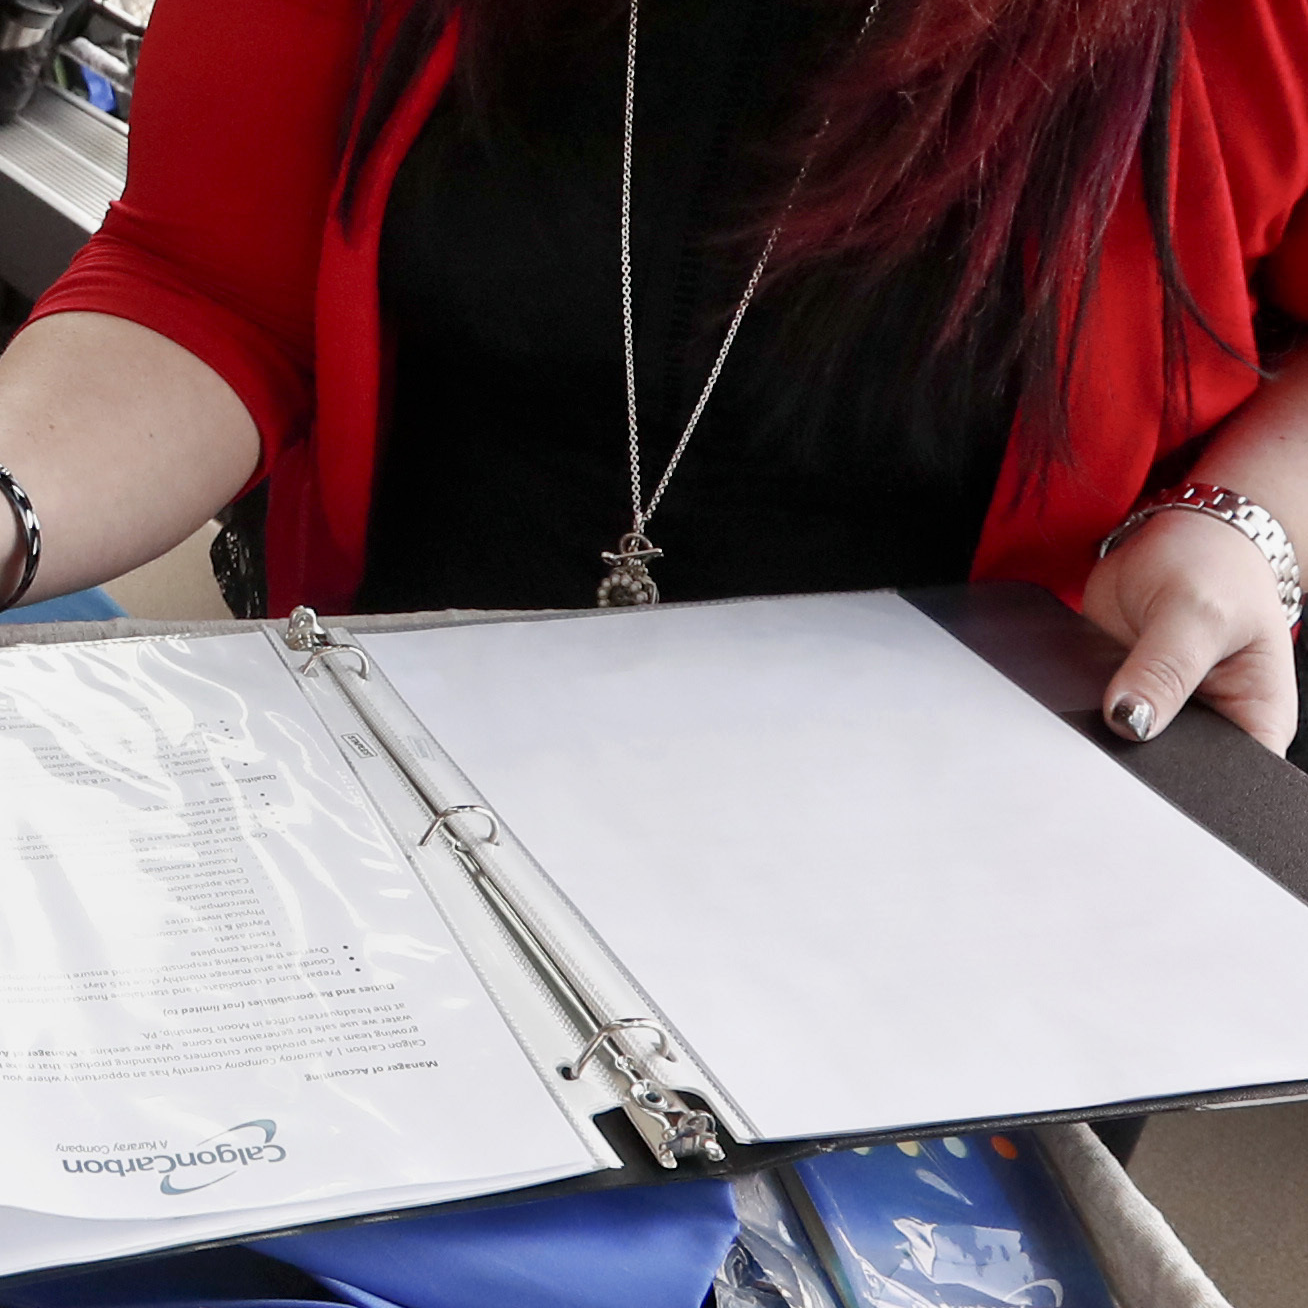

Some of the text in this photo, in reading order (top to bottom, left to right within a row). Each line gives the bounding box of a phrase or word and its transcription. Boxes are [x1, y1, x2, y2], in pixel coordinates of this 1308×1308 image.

[210, 775, 277, 788] Qualificaons
[213, 832, 268, 845] Coodinate
[198, 857, 239, 869] Account
[194, 867, 244, 879] Derivative
[167, 877, 250, 893] Cash application
[175, 888, 255, 903] Product costing
[189, 898, 260, 912] Intercompany
[224, 908, 266, 920] Physical
[234, 919, 271, 931] Payroll
[214, 930, 277, 942] Fixed assets
[190, 941, 282, 957] Percent complete
[286, 947, 329, 958] Overee
[254, 965, 273, 974] and
[277, 957, 336, 971] Coordiate
[163, 973, 207, 984] monthly
[210, 968, 252, 979] manage
[278, 969, 342, 982] Prepartion
[265, 977, 276, 985] of
[359, 983, 395, 993] Duties
[223, 1000, 245, 1010] (not
[248, 991, 333, 1008] Reponsibilities
[181, 1005, 220, 1016] limited
[372, 1004, 391, 1014] the
[392, 1002, 406, 1011] at
[266, 1018, 296, 1028] office
[339, 1020, 359, 1029] use
[362, 1019, 378, 1027] we
[382, 1014, 413, 1025] water
[217, 1022, 251, 1032] Moon
[295, 1026, 313, 1036] for
[375, 1025, 419, 1039] growing
[215, 1038, 227, 1046] to
[329, 1035, 341, 1043] as
[344, 1032, 372, 1042] team
[156, 1043, 174, 1051] We
[244, 1045, 262, 1054] our
[266, 1039, 307, 1053] provide
[346, 1043, 386, 1054] Carbon
[388, 1039, 426, 1050] Calgon
[92, 1046, 132, 1056] seekin
[183, 1049, 241, 1061] customers
[5, 1062, 34, 1071] mke
[37, 1062, 60, 1071] that
[65, 1058, 112, 1070] product
[115, 1055, 181, 1067] outstanding
[225, 1058, 276, 1070] Company
[149, 1069, 170, 1078] has
[171, 1063, 222, 1076] currently
[304, 1059, 439, 1082] Manager of Accounting
[2, 1073, 23, 1083] you
[26, 1074, 61, 1083] where
[64, 1071, 130, 1083] opportunity
[55, 1140, 168, 1155] A Kuraray Company
[62, 1143, 286, 1177] CalgonCarbon
